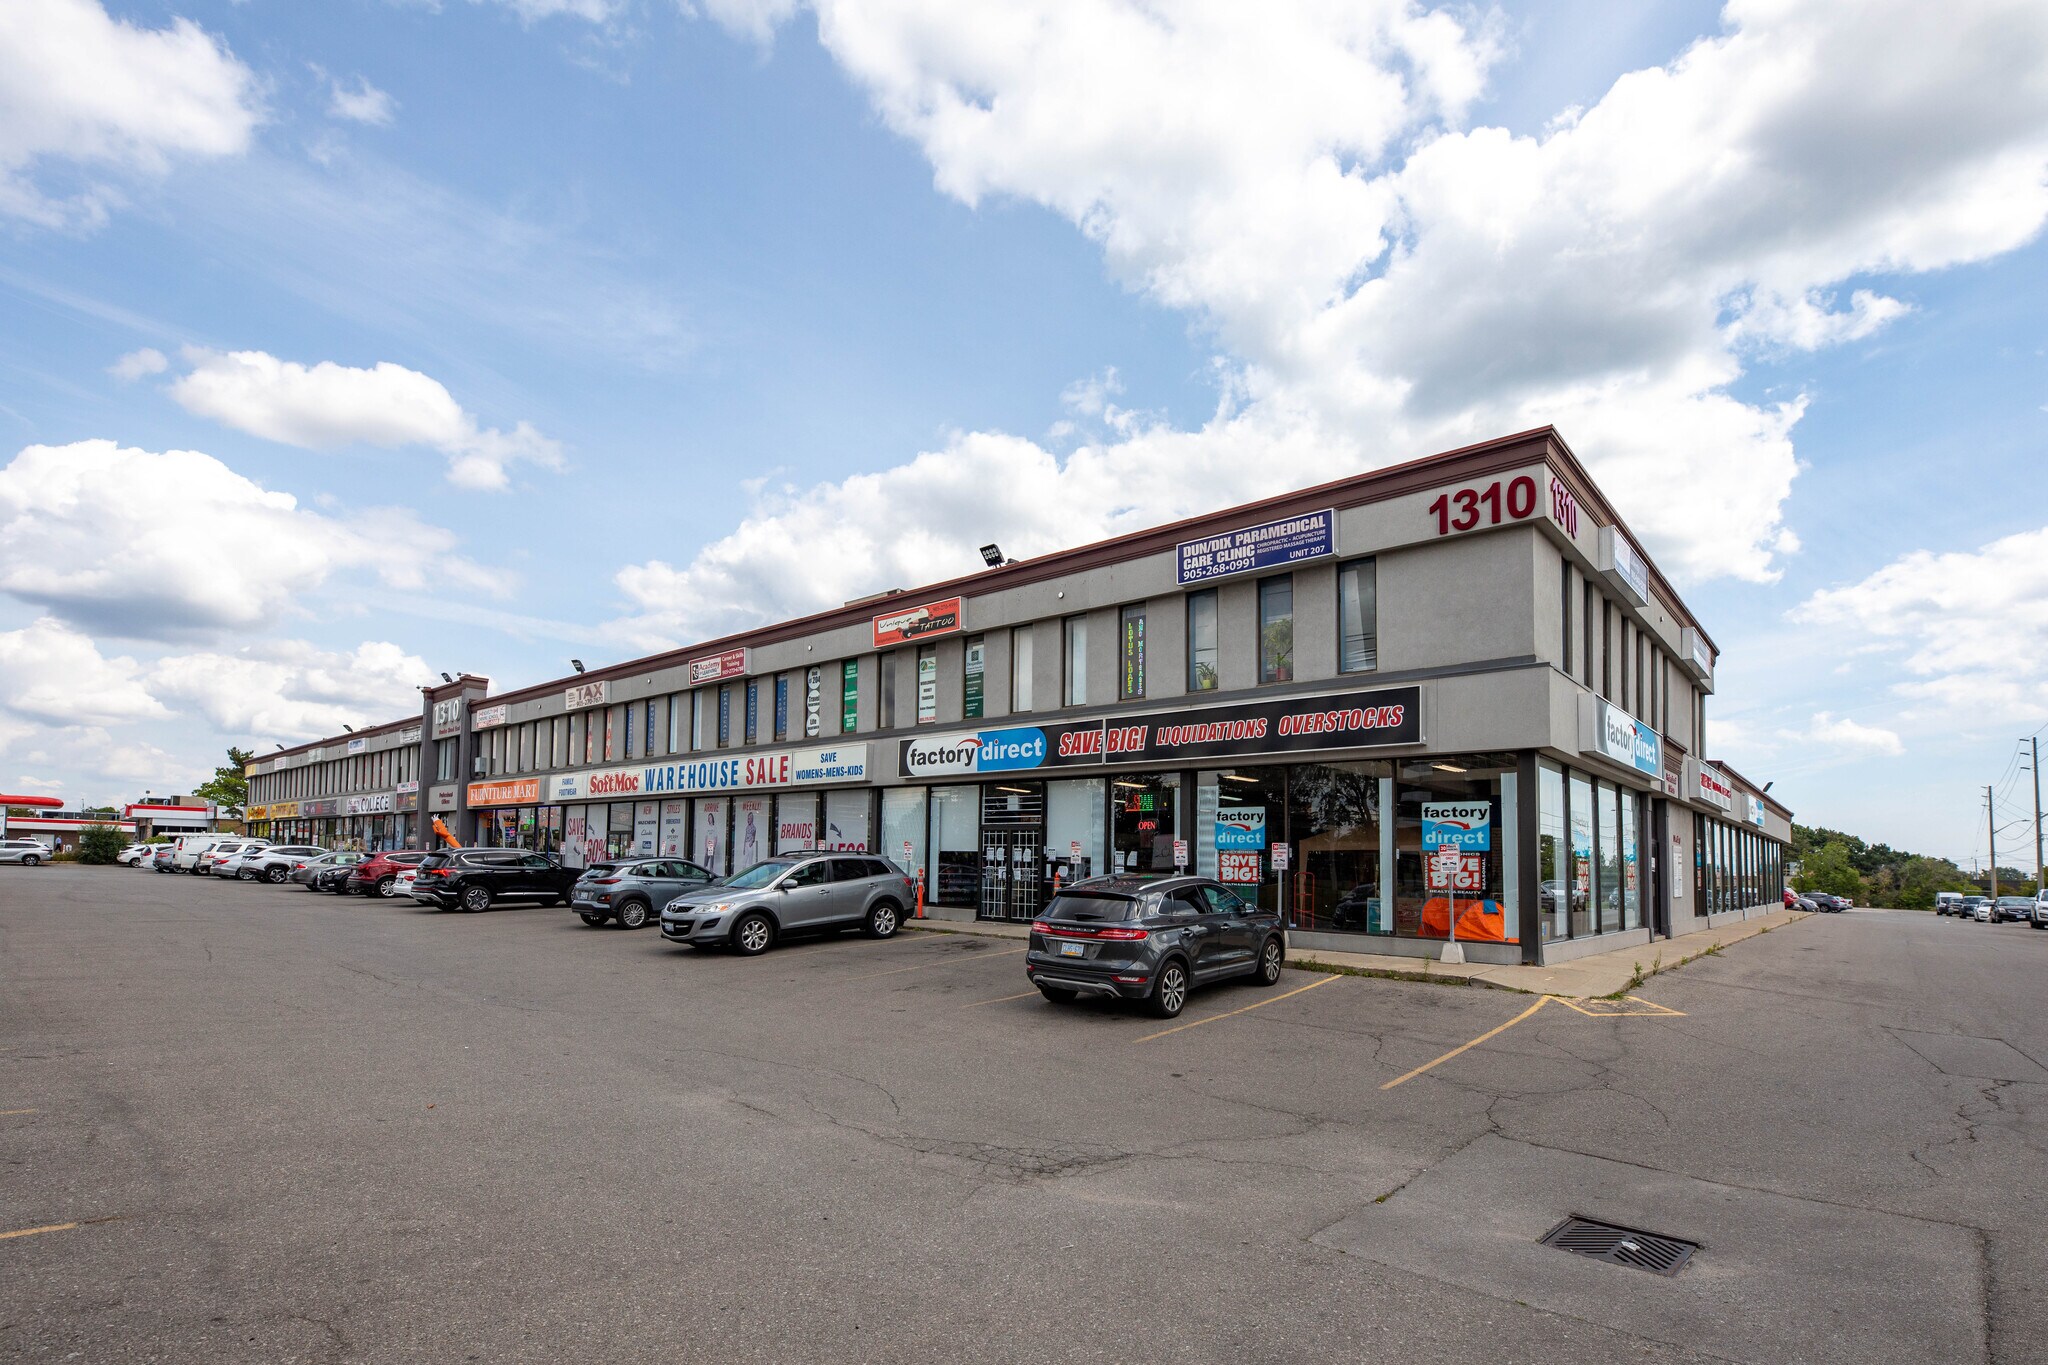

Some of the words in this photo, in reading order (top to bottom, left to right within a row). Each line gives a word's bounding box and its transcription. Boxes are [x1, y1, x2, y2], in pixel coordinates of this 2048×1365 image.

[1429, 476, 1537, 535] 1310
[1551, 477, 1579, 539] 1310
[1183, 536, 1232, 558] DUN/DIX
[1235, 515, 1326, 545] PARAMEDICAL
[1256, 538, 1288, 549] CHIROPRACTIC
[1292, 529, 1326, 540] ACUPUNCTURE
[1256, 544, 1283, 554] REGISTERED
[1284, 539, 1305, 549] MASSAGE
[1305, 535, 1326, 544] THERAPY
[1183, 555, 1213, 571] CARE
[1216, 544, 1256, 563] CLINIC
[1289, 549, 1308, 559] UNIT
[1310, 545, 1326, 555] 207
[879, 617, 912, 629] Unique
[919, 616, 954, 632] TATTOO
[699, 661, 721, 670] Academy
[576, 682, 603, 701] TAX
[434, 699, 461, 726] 1310
[910, 747, 975, 767] factory
[981, 737, 1043, 761] direct
[1059, 730, 1103, 757] SAVE
[1105, 724, 1149, 754] BIG!
[1155, 718, 1268, 746] LIQUIDATIONS
[1277, 705, 1405, 736] OVERSTOCKS
[1606, 714, 1635, 760] factory
[1635, 733, 1656, 765] direct
[820, 752, 837, 764] SAVE
[589, 771, 639, 794] SoftMoc
[645, 760, 739, 792] WAREHOUSE
[746, 755, 788, 785] SALE
[795, 764, 863, 780] WOMENS-MENS-KIDS
[561, 777, 574, 786] FAMILY
[470, 786, 511, 801] FURNITURE
[513, 783, 537, 799] MART
[558, 787, 577, 797] FOOTWEAR
[703, 802, 720, 813] ARRIVE
[1424, 806, 1488, 820] factory
[1217, 811, 1264, 823] factory
[568, 818, 584, 837] SAVE
[781, 822, 813, 839] BRANDS
[1138, 821, 1156, 830] OPEN
[803, 840, 813, 849] FOR
[1217, 832, 1262, 844] direct
[1425, 830, 1485, 844] direct
[586, 839, 607, 863] 60%
[1221, 854, 1257, 867] SAVE
[1221, 867, 1258, 881] BIG!
